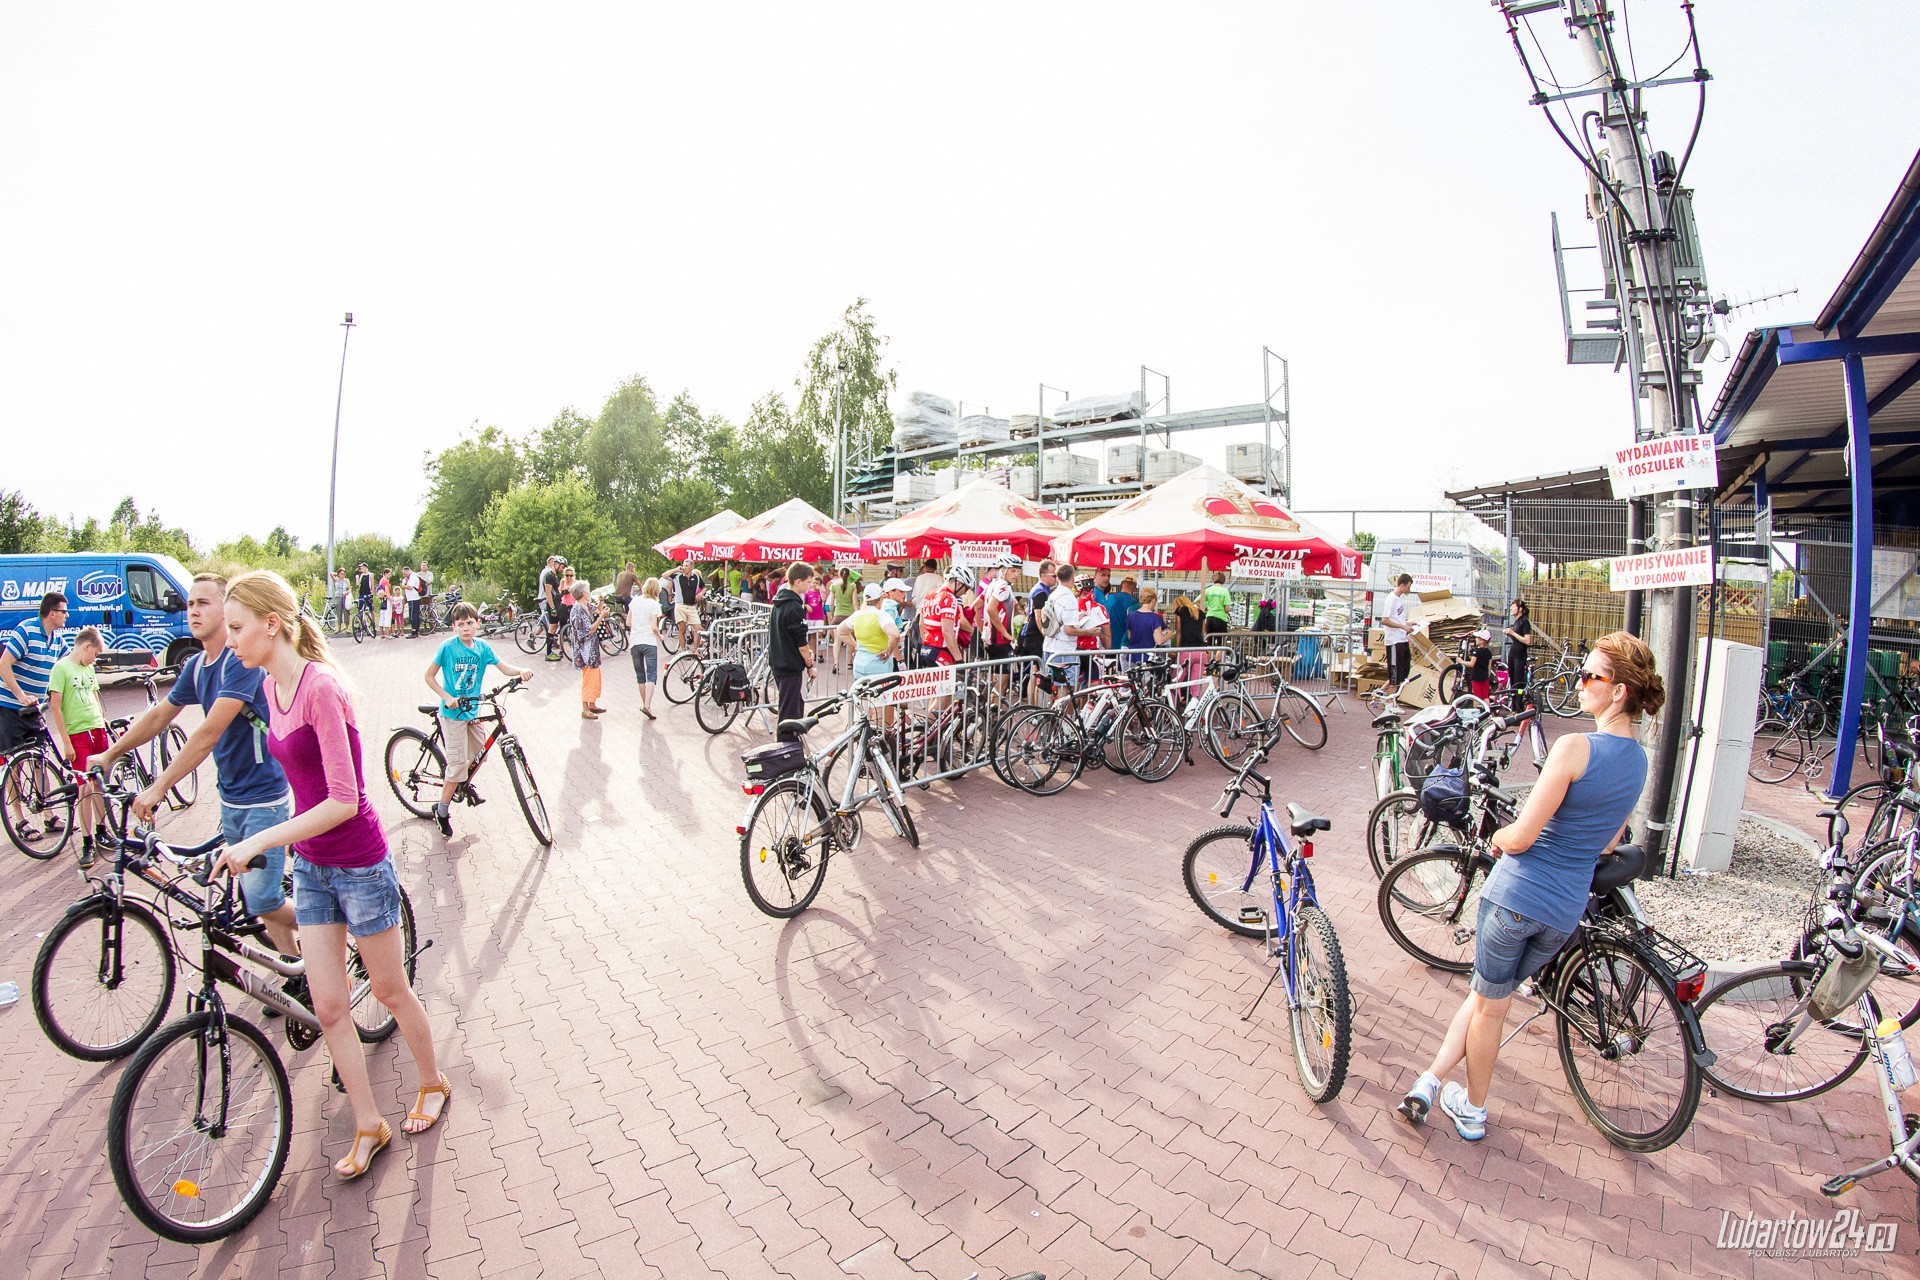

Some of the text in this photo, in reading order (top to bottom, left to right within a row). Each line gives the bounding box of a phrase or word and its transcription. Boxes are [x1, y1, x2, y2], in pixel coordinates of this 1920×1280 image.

[1616, 438, 1700, 464] WYDAWANIE
[1627, 456, 1685, 477] KOSZULEK
[711, 544, 736, 558] TYSKIE
[758, 545, 805, 561] TYSKIE
[870, 539, 908, 557] TYSKIE
[1099, 541, 1176, 568] TYSKIE
[1237, 558, 1296, 570] WYDAWANIE
[1615, 549, 1708, 573] WYPISYWANIE
[1248, 568, 1285, 578] KOSZULEK
[1634, 571, 1687, 586] DYPLOMÓW
[76, 578, 123, 596] Luvi
[78, 603, 123, 612] www.luvi.pl
[881, 670, 950, 688] DAWANIE
[892, 685, 937, 701] KOSZULEK
[1424, 683, 1437, 703] JHK
